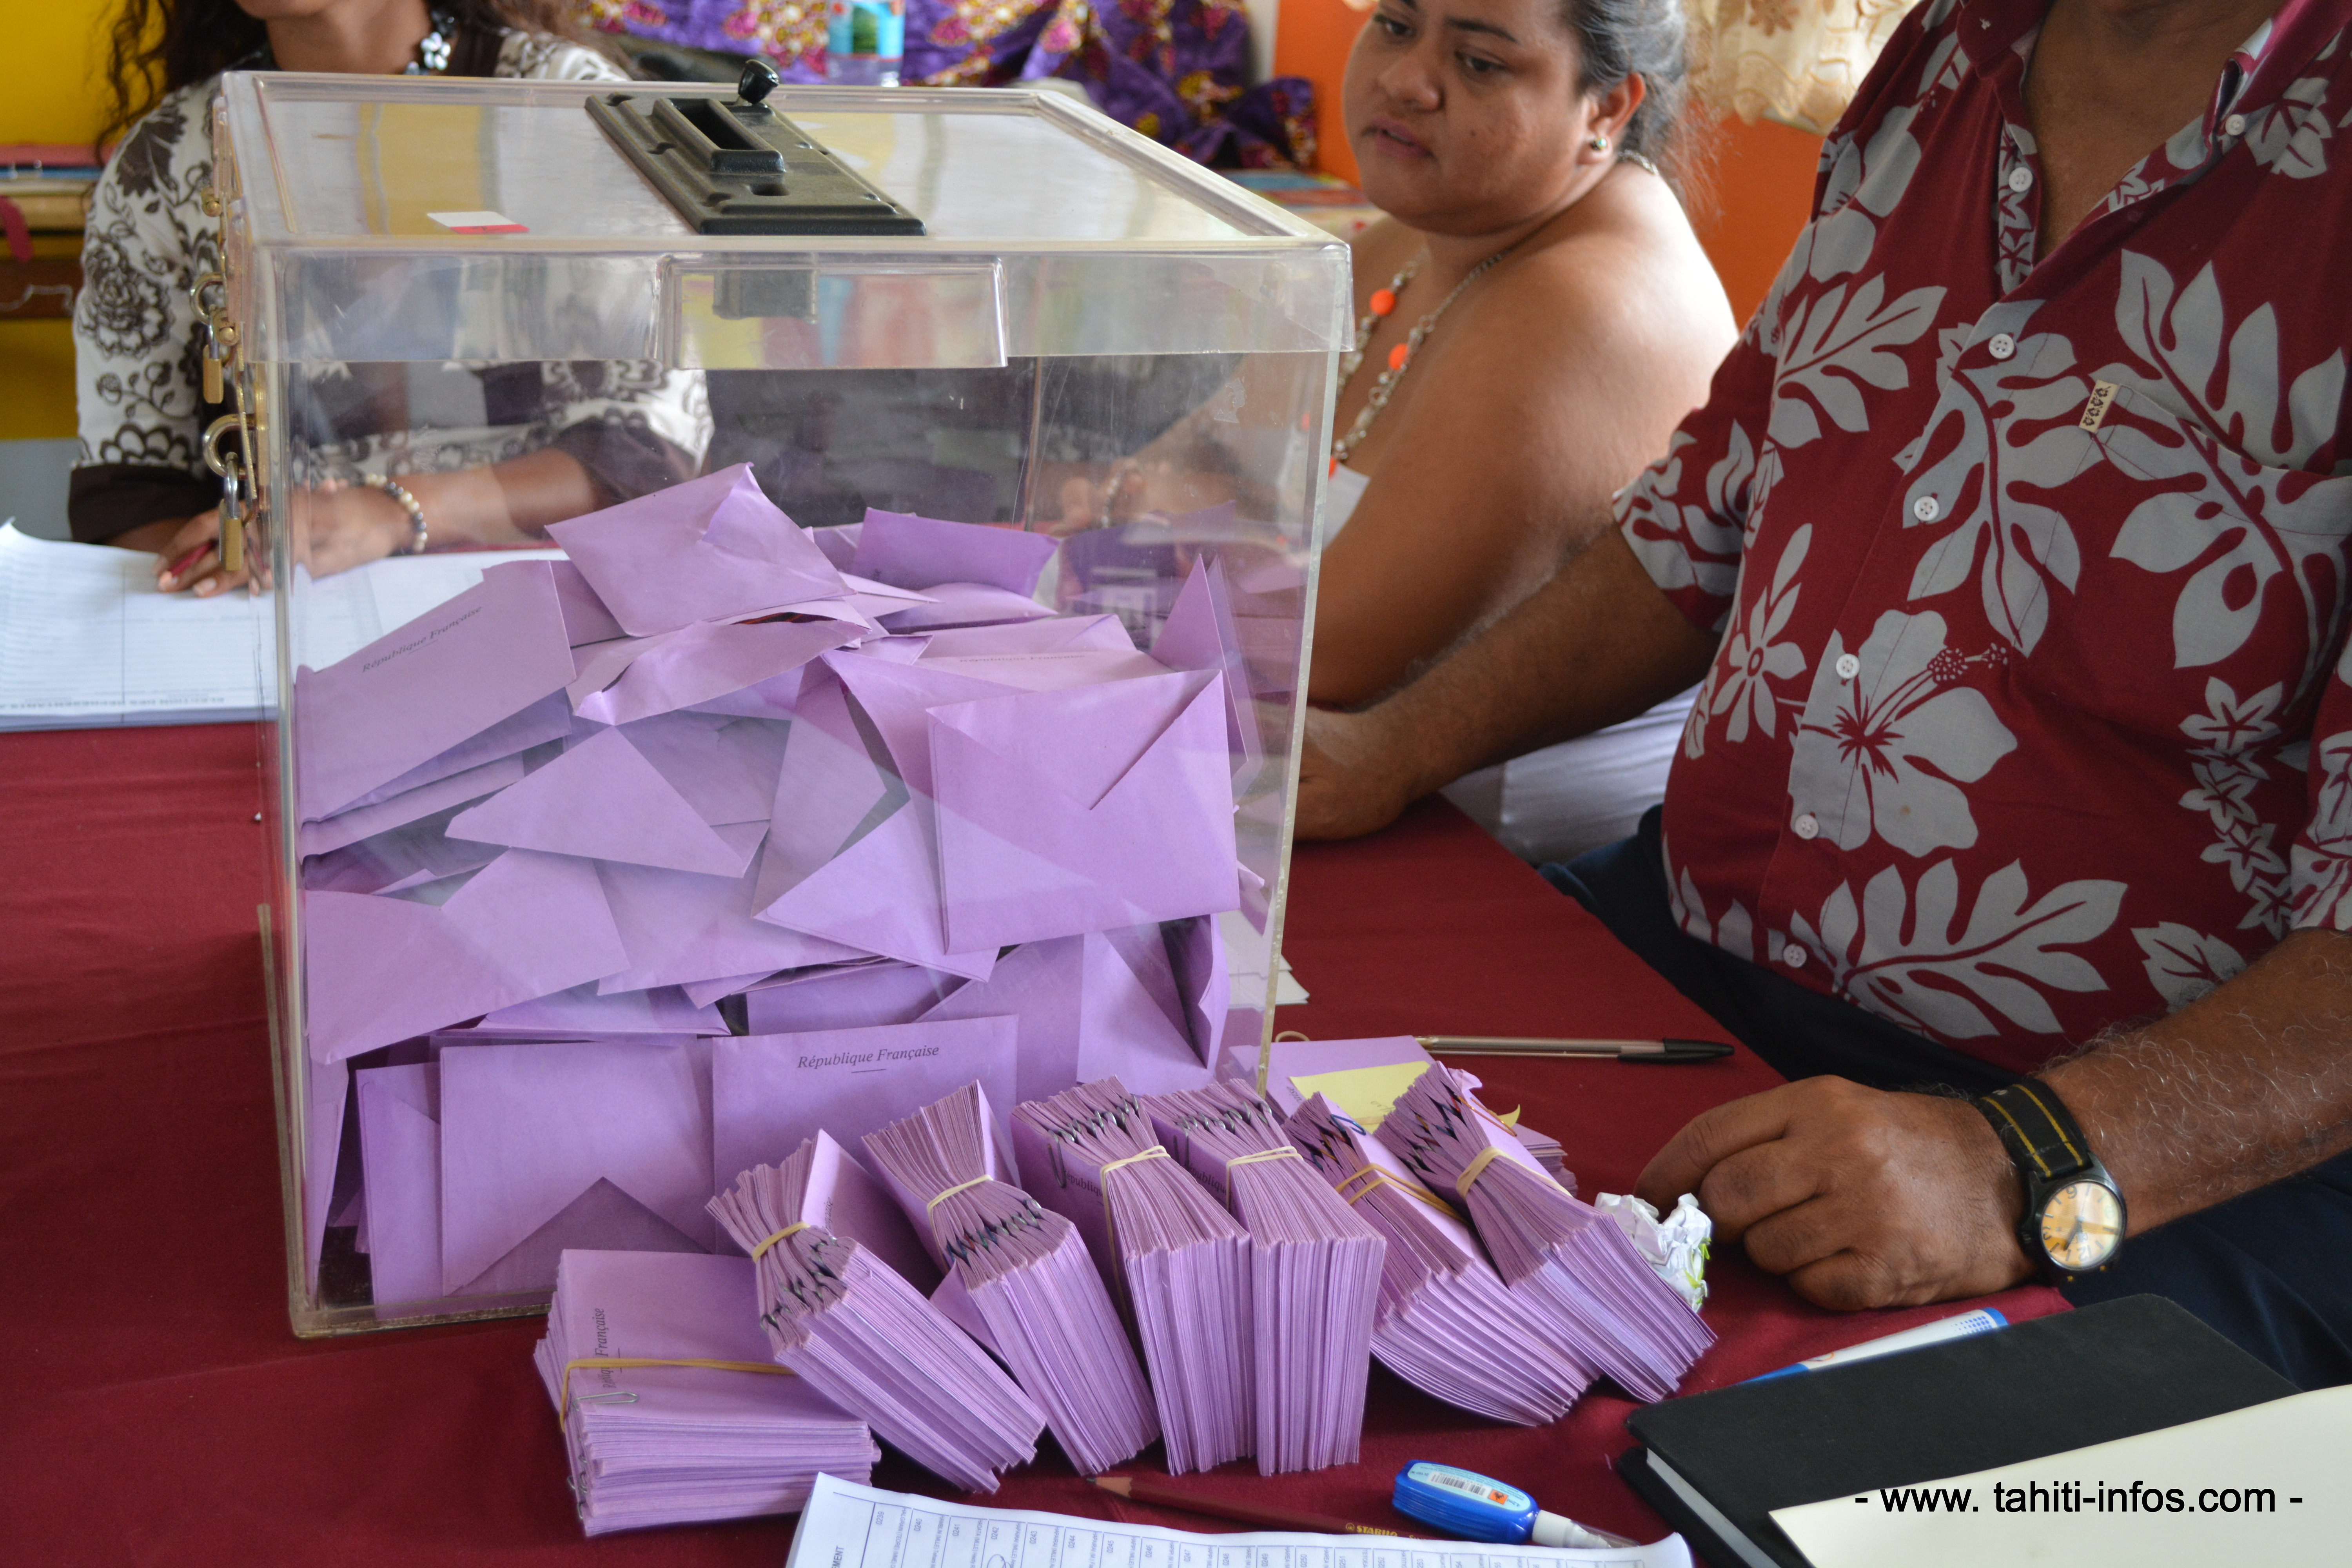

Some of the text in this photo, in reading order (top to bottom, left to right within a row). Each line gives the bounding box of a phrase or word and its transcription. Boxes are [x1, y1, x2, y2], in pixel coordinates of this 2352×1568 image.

[363, 606, 482, 672] République Française
[797, 1045, 939, 1069] République Française
[592, 1308, 609, 1357] Française
[875, 1511, 885, 1526] 0239
[914, 1518, 923, 1532] 0240
[936, 1515, 945, 1534] HAMBLIN
[952, 1523, 960, 1537] 0241
[991, 1527, 999, 1540] 0242
[1029, 1530, 1038, 1544] 0243
[1068, 1535, 1076, 1548] 0244
[1107, 1540, 1115, 1553] 0245
[1183, 1549, 1192, 1563] 0247
